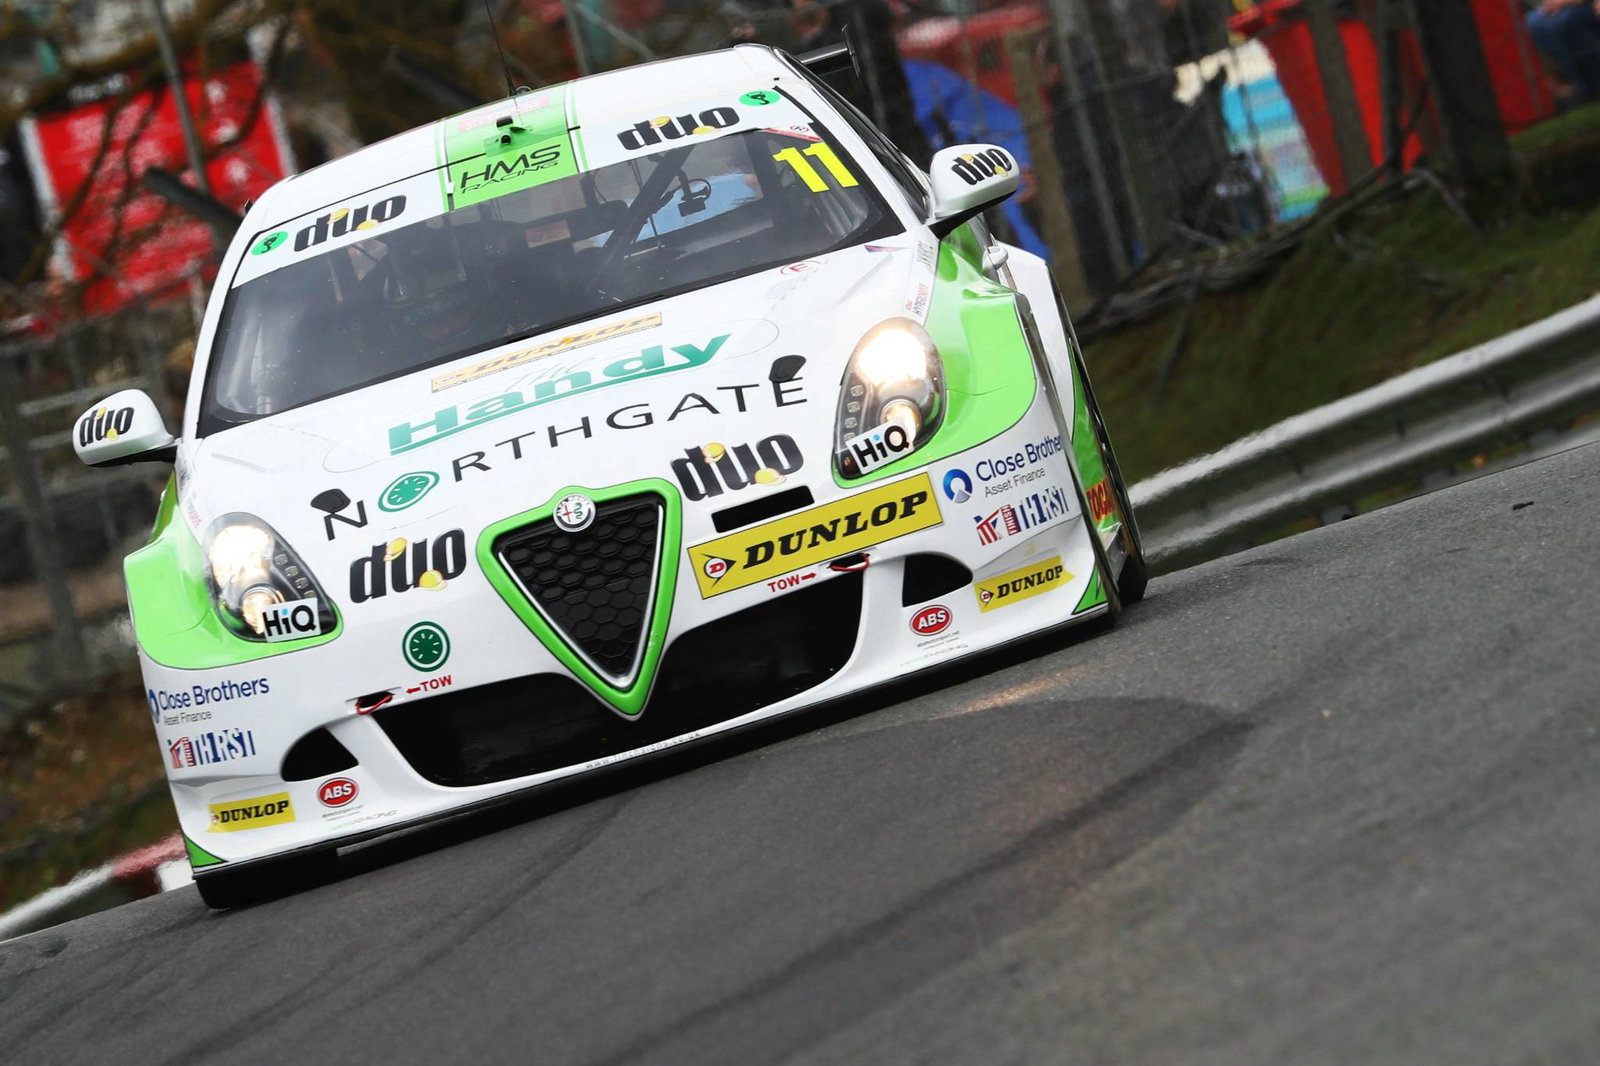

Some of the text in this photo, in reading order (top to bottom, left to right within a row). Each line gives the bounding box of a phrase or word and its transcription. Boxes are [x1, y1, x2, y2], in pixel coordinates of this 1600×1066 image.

[617, 107, 740, 151] duo
[460, 144, 561, 189] HMS
[462, 161, 558, 195] RACING
[773, 141, 859, 193] 11
[951, 147, 1014, 186] duo
[294, 195, 407, 252] duo
[389, 333, 732, 452] Handy
[79, 406, 134, 447] duo
[852, 425, 910, 468] HiQ
[671, 433, 804, 502] duo
[975, 452, 1026, 482] Close
[984, 466, 1047, 498] Asset Finance
[742, 490, 928, 570] DUNLOP
[349, 527, 468, 604] duo
[767, 574, 801, 593] TOW
[996, 563, 1064, 600] DUNLOP
[262, 604, 317, 638] HiQ
[917, 611, 947, 631] ABS
[157, 677, 270, 714] Close Brothers
[420, 674, 453, 693] TOW
[180, 707, 213, 723] Finance
[322, 780, 354, 801] ABS
[219, 800, 290, 825] DUNLOP
